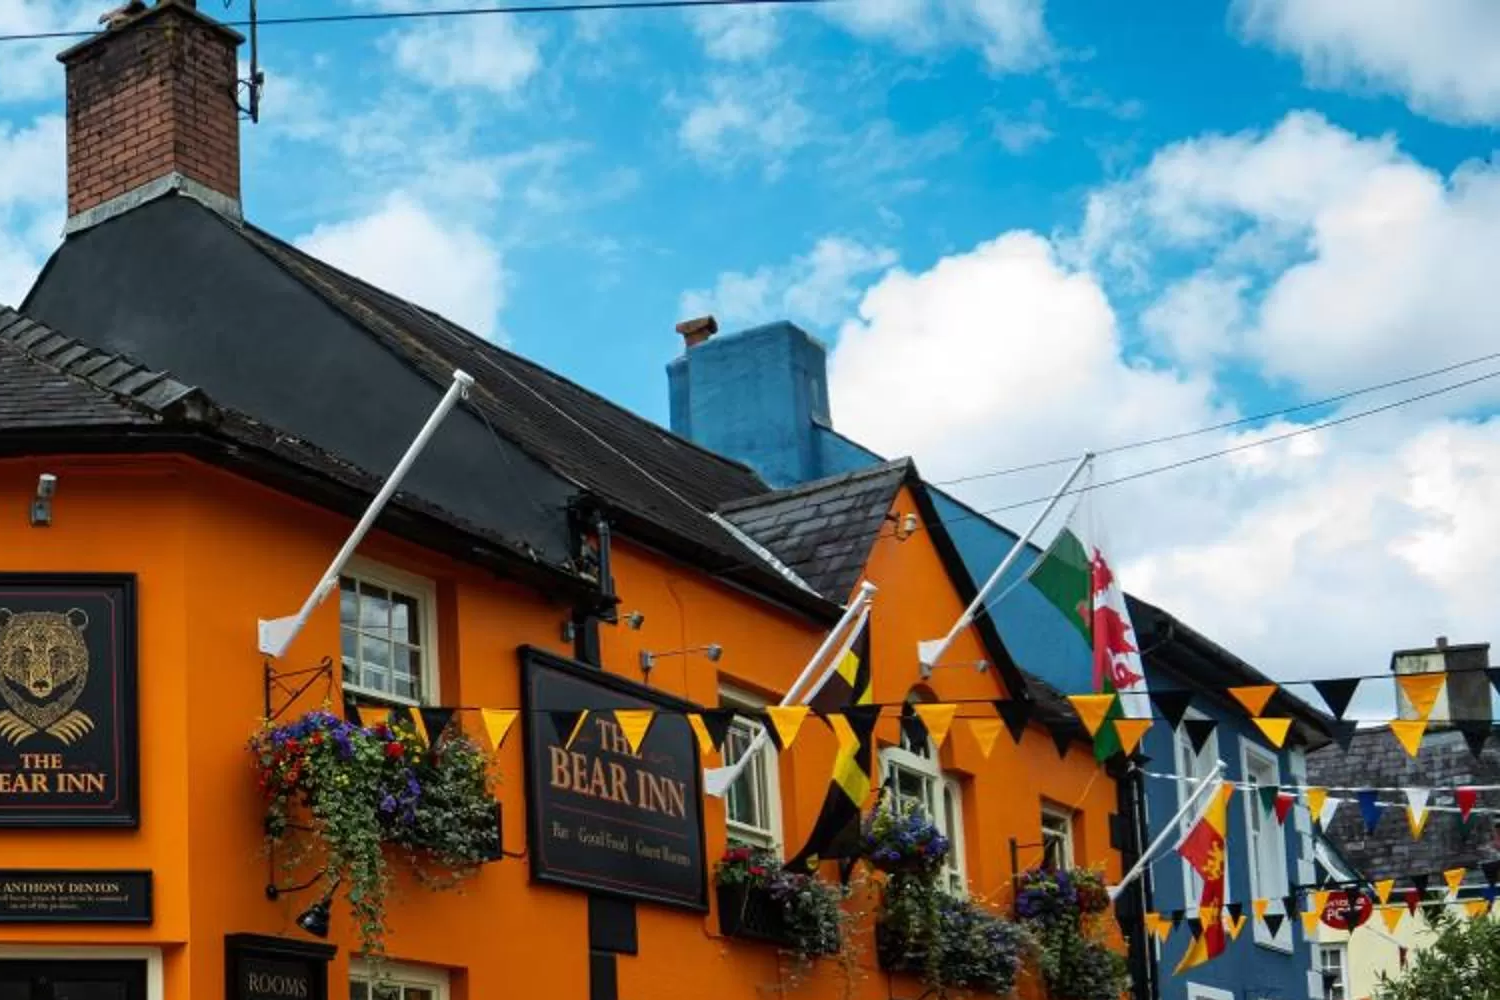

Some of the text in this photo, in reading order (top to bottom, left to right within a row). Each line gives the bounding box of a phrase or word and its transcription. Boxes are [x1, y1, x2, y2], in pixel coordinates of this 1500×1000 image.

[596, 718, 642, 759] TH
[20, 753, 63, 769] THE
[57, 773, 107, 793] INN
[548, 745, 686, 819] BEAR INN
[3, 882, 66, 893] ANTHONY
[69, 882, 119, 893] DENTON
[248, 972, 308, 997] ROOMS
